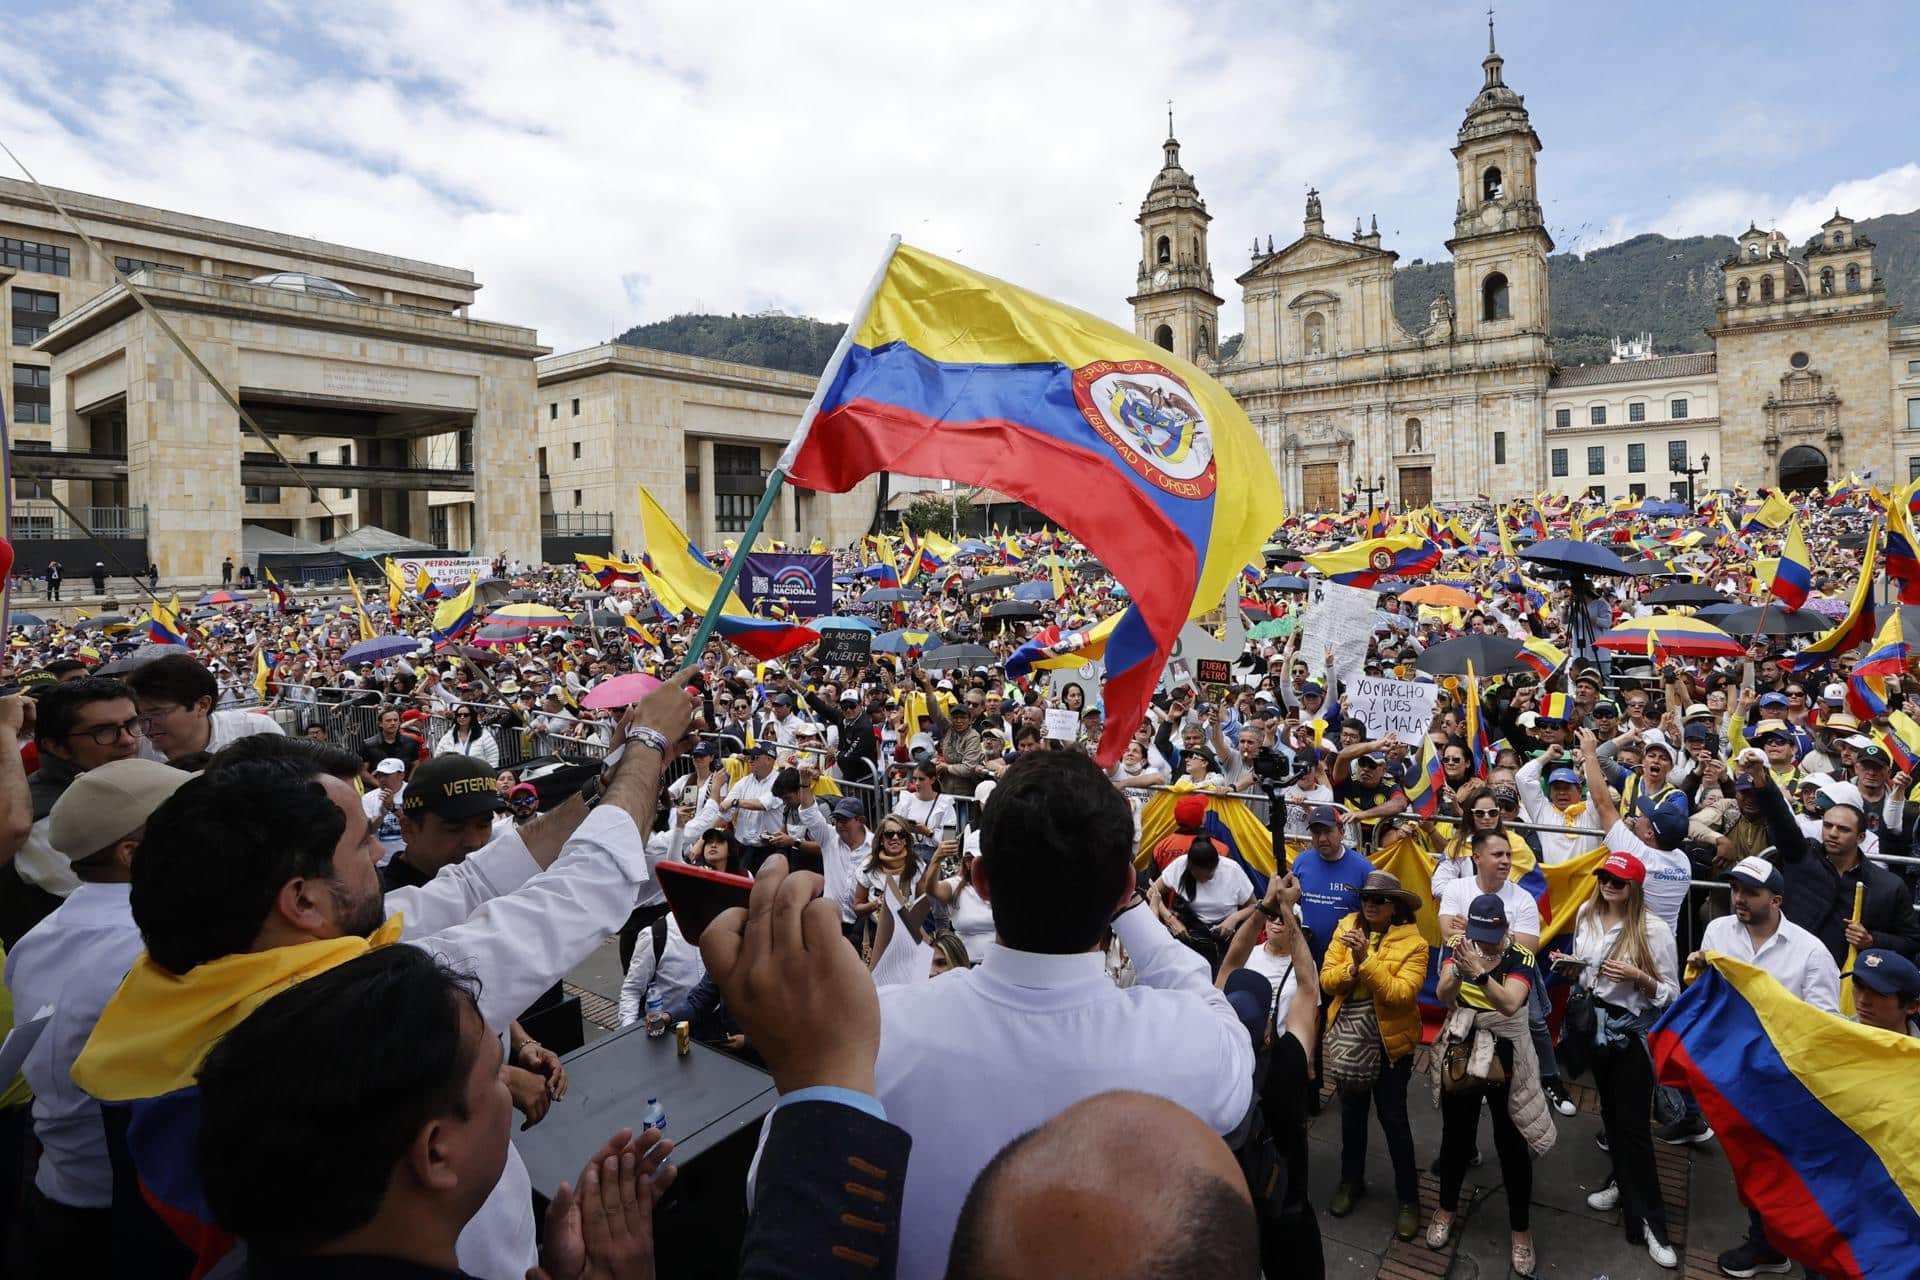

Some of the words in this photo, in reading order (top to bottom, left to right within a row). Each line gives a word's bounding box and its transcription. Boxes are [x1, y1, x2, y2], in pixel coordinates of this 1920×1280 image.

[1084, 407, 1138, 464] LIBERTAD
[1143, 465, 1153, 477] Y
[1158, 476, 1201, 496] ORDEN
[773, 588, 817, 596] NACIONAL
[835, 631, 868, 641] ABORTO
[837, 642, 850, 650] ES
[825, 650, 866, 662] MUERTE
[1201, 661, 1227, 671] FUERA
[1200, 670, 1227, 680] PETRO
[1369, 698, 1376, 711] Y
[1383, 699, 1412, 713] PUES
[1354, 709, 1383, 730] DE
